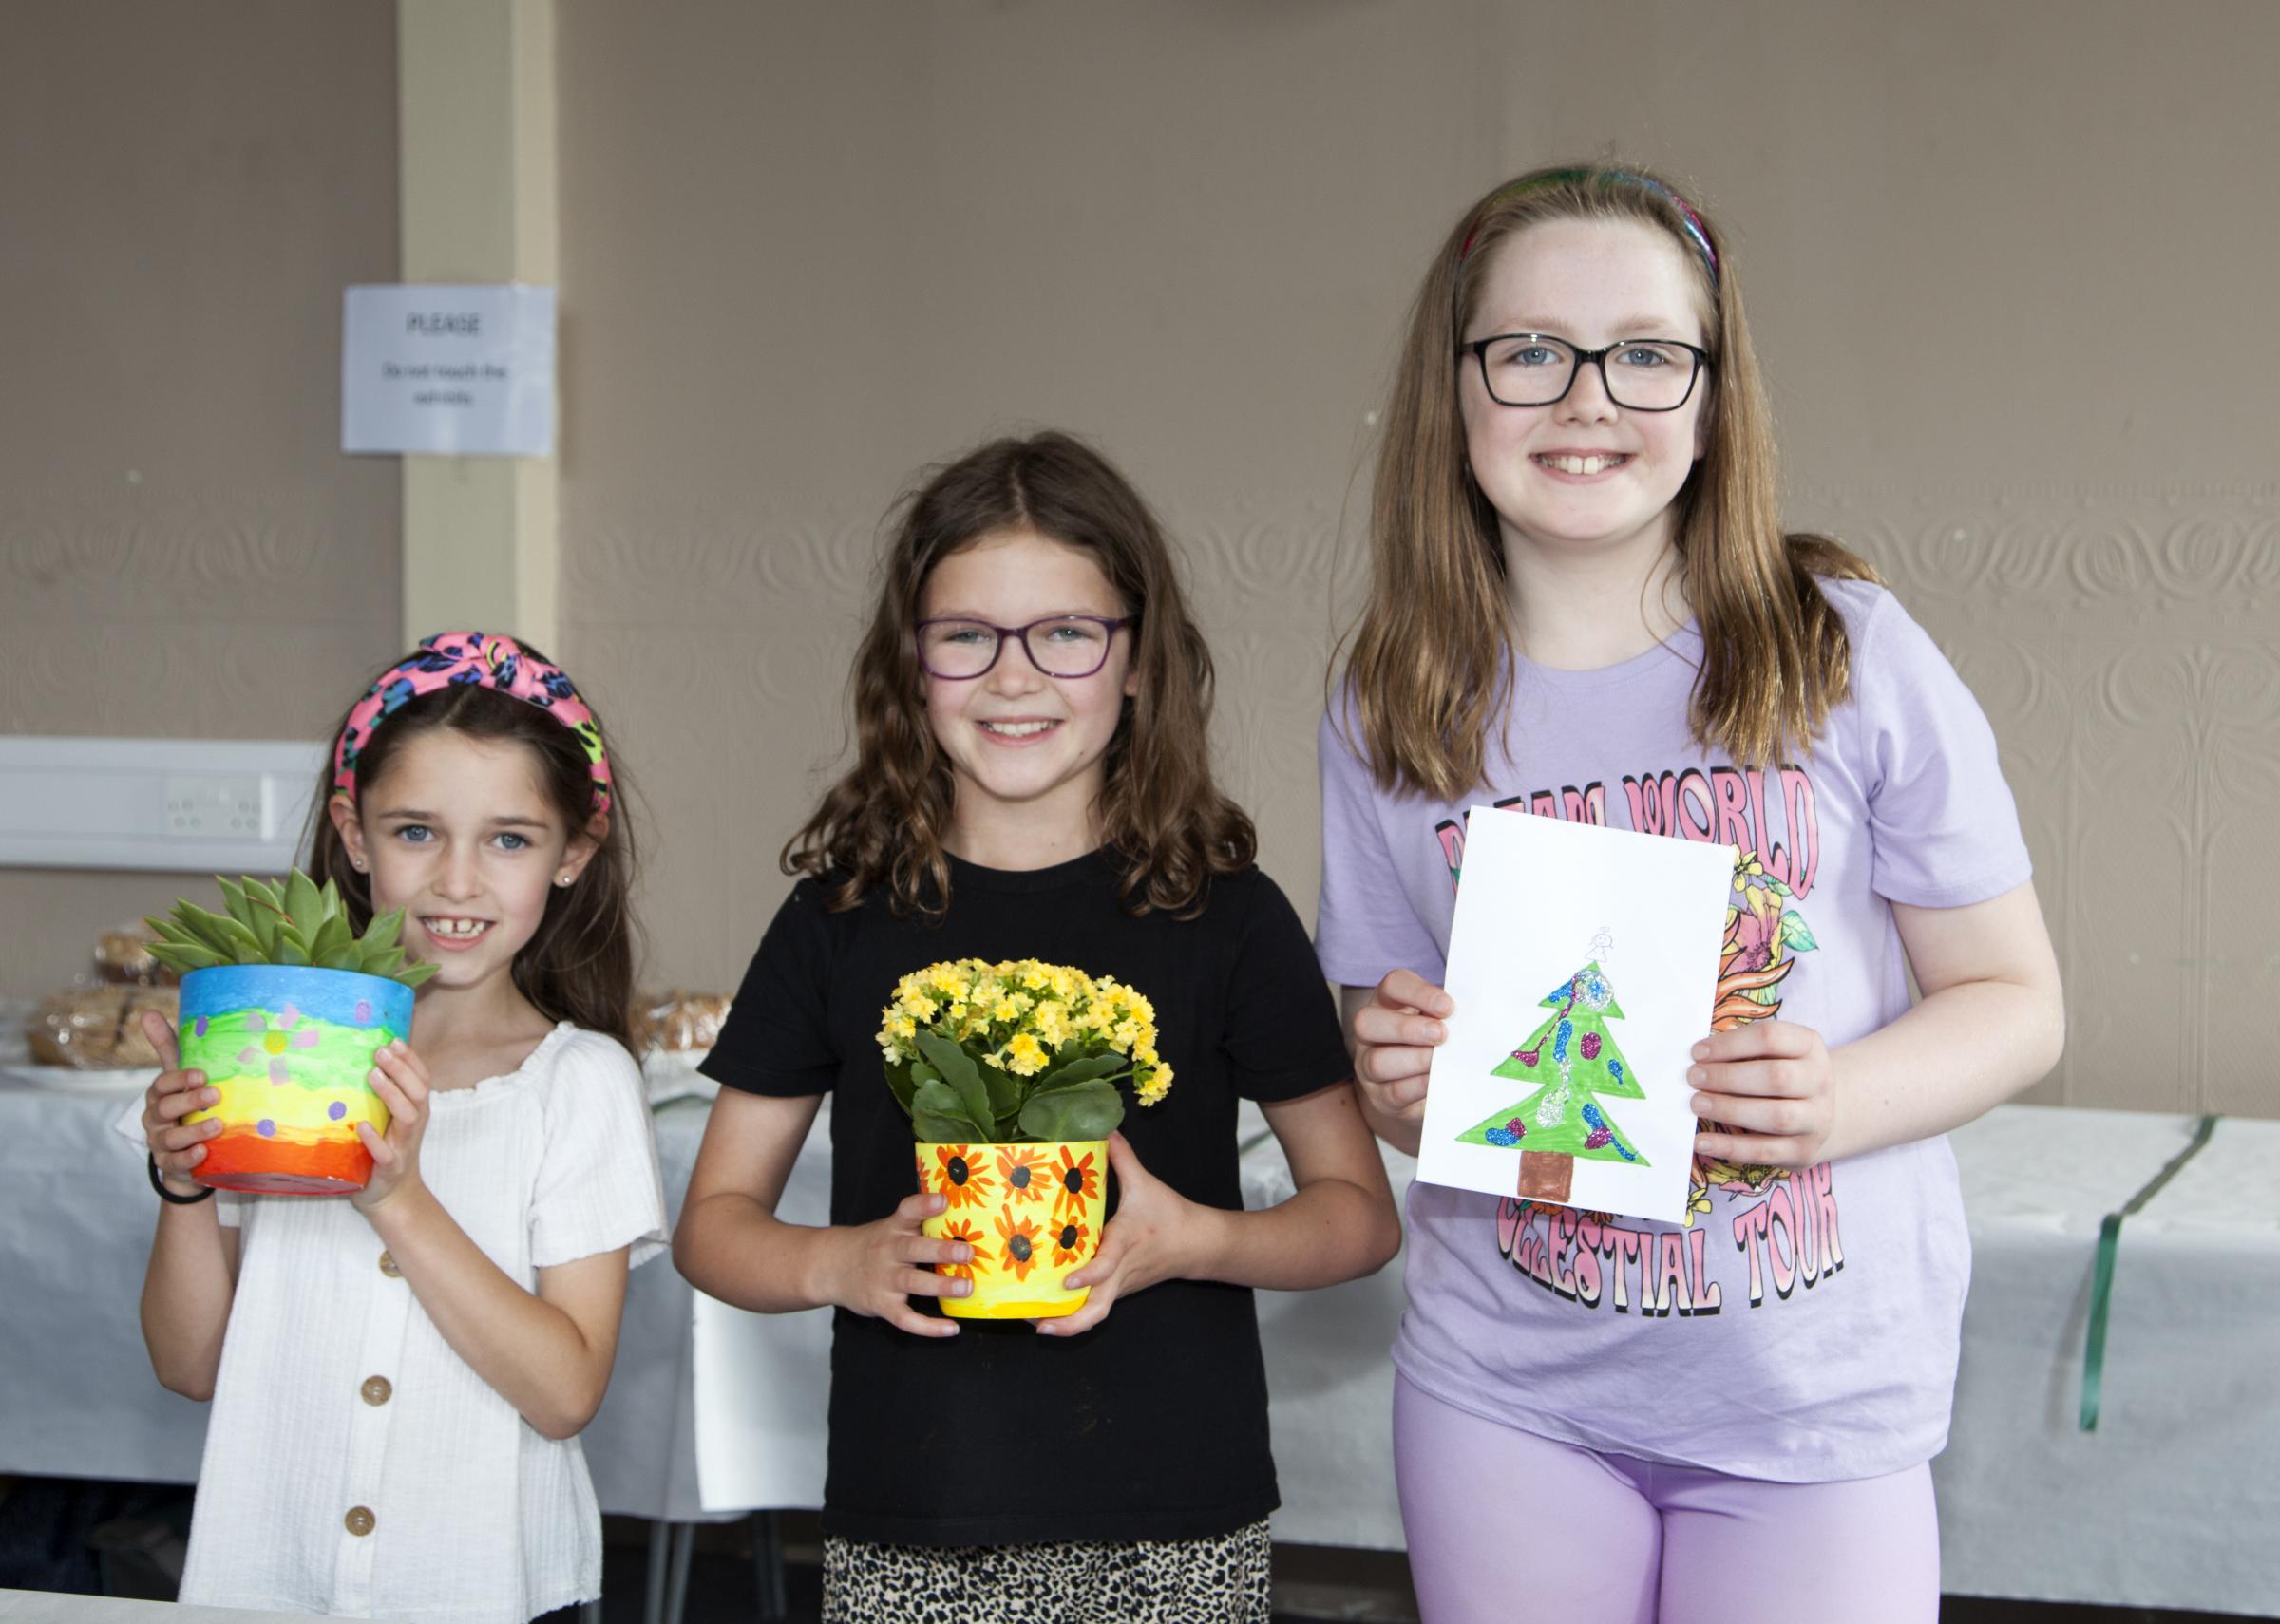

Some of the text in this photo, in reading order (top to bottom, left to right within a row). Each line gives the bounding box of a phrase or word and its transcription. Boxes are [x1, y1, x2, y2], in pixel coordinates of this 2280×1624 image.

[406, 312, 481, 336] PLEASE
[1622, 763, 1820, 900] WORLD
[1733, 1161, 1845, 1309] TOUR
